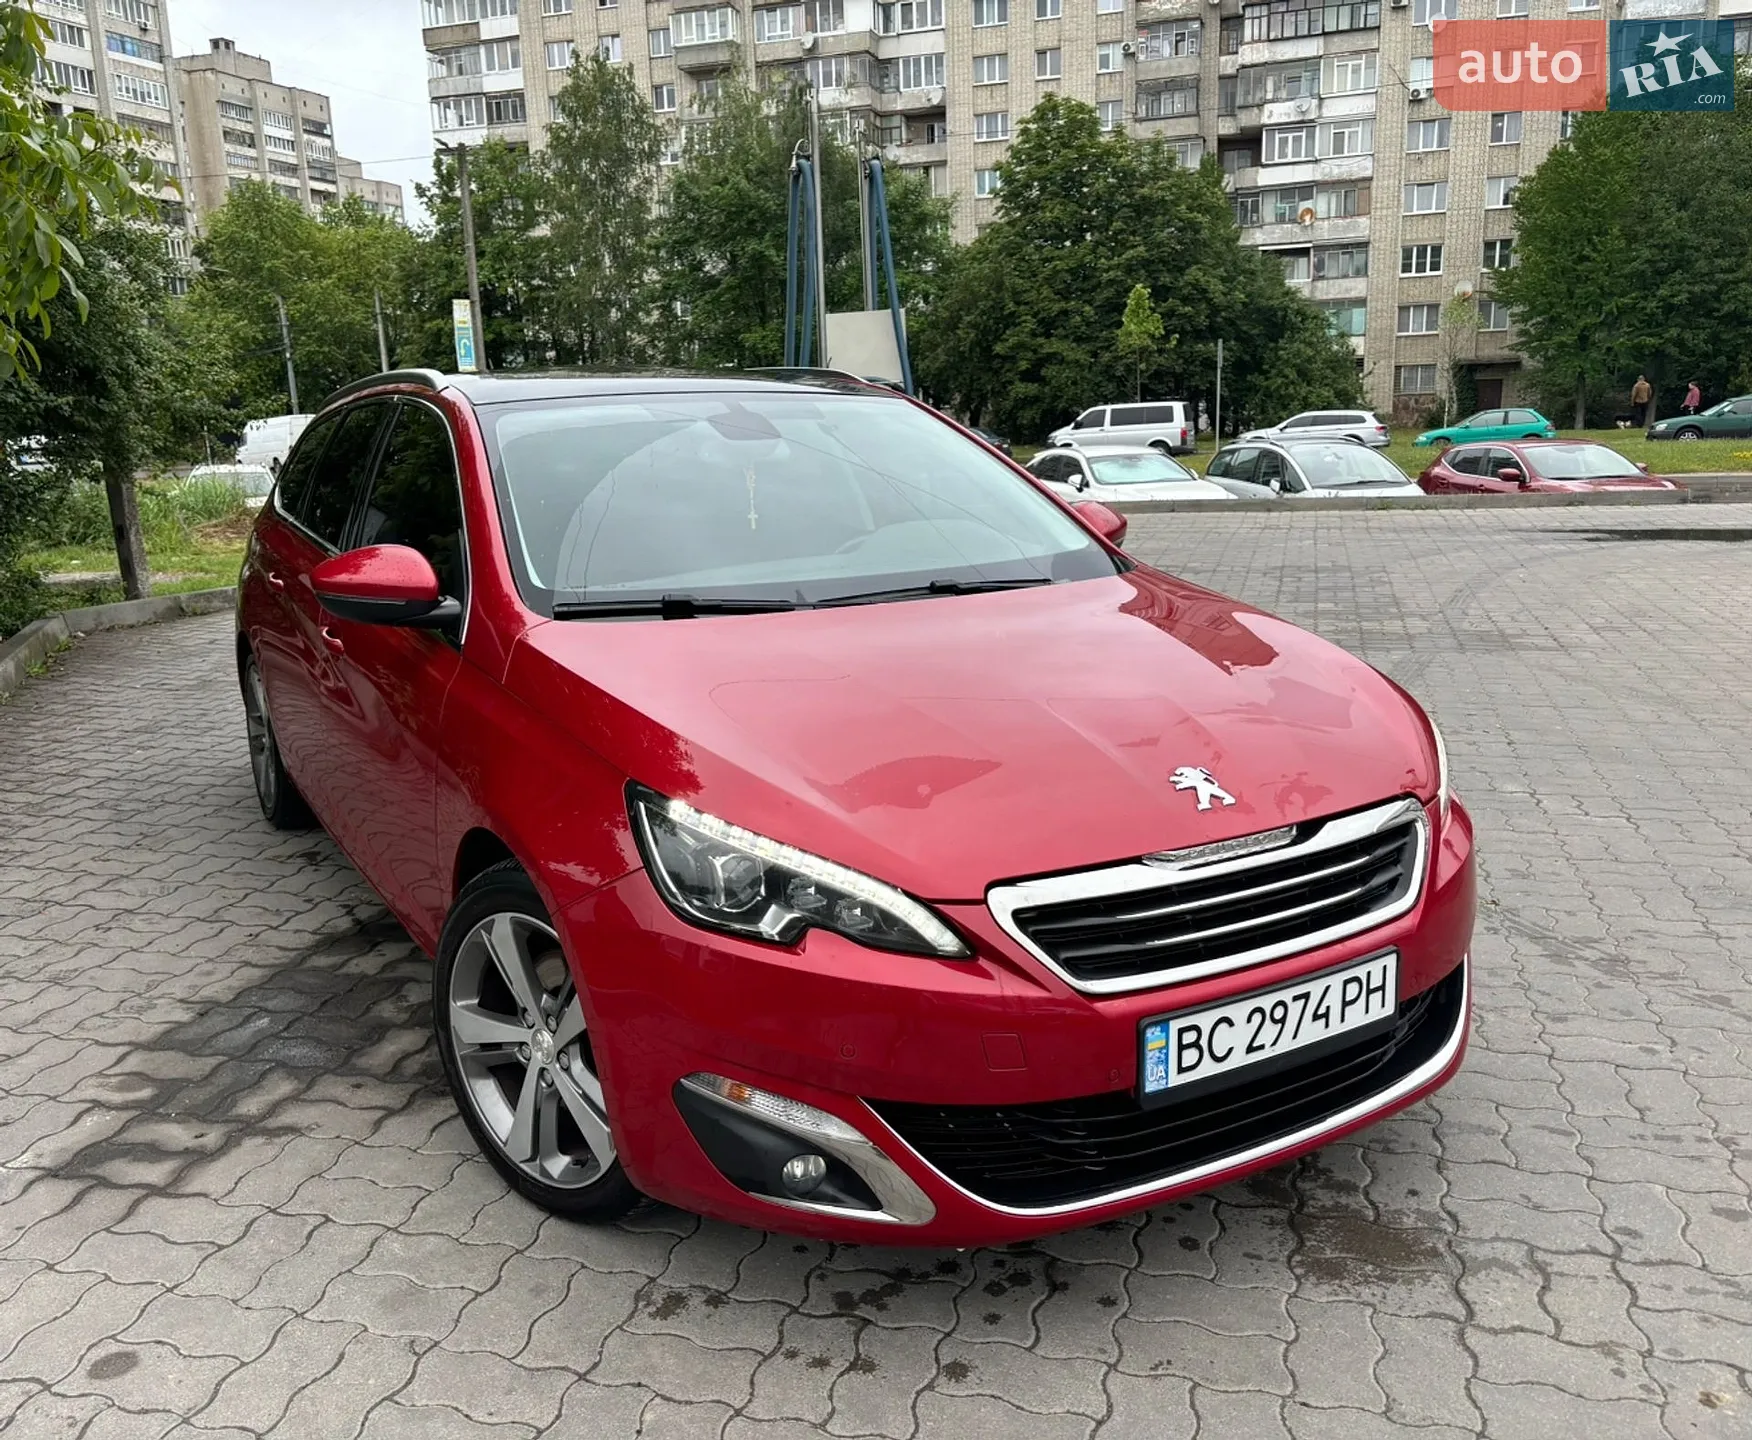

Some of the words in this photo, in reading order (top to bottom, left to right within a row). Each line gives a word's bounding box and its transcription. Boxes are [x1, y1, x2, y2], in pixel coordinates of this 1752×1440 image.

[1176, 1015, 1236, 1075] BC
[1244, 983, 1333, 1056] 2974
[1339, 963, 1388, 1024] PH
[1146, 1064, 1167, 1083] UA
